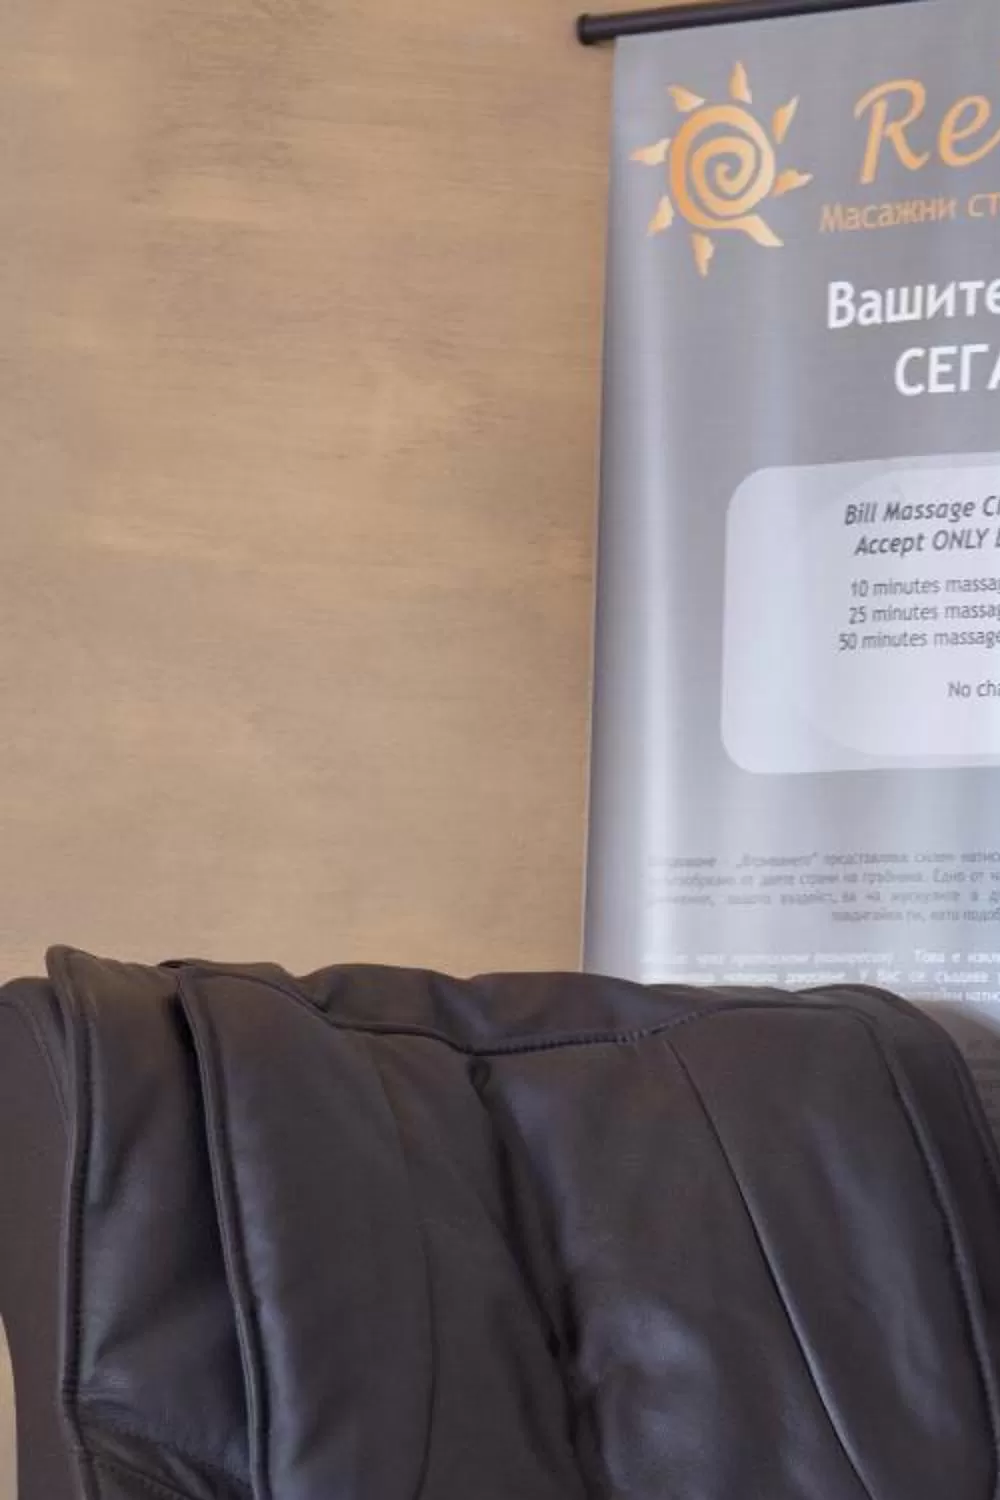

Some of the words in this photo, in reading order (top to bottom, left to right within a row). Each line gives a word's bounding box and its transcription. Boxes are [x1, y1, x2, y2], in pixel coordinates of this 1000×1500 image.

[819, 196, 956, 234] Масажни
[844, 502, 877, 525] Bill
[883, 498, 976, 523] Massage
[854, 532, 925, 557] Accept
[931, 527, 989, 552] ONLY
[850, 579, 869, 598] 10
[872, 577, 942, 597] minutes
[848, 605, 866, 625] 25
[872, 603, 939, 623] minutes
[838, 632, 857, 651] 50
[861, 630, 928, 650] minutes
[947, 680, 971, 699] No
